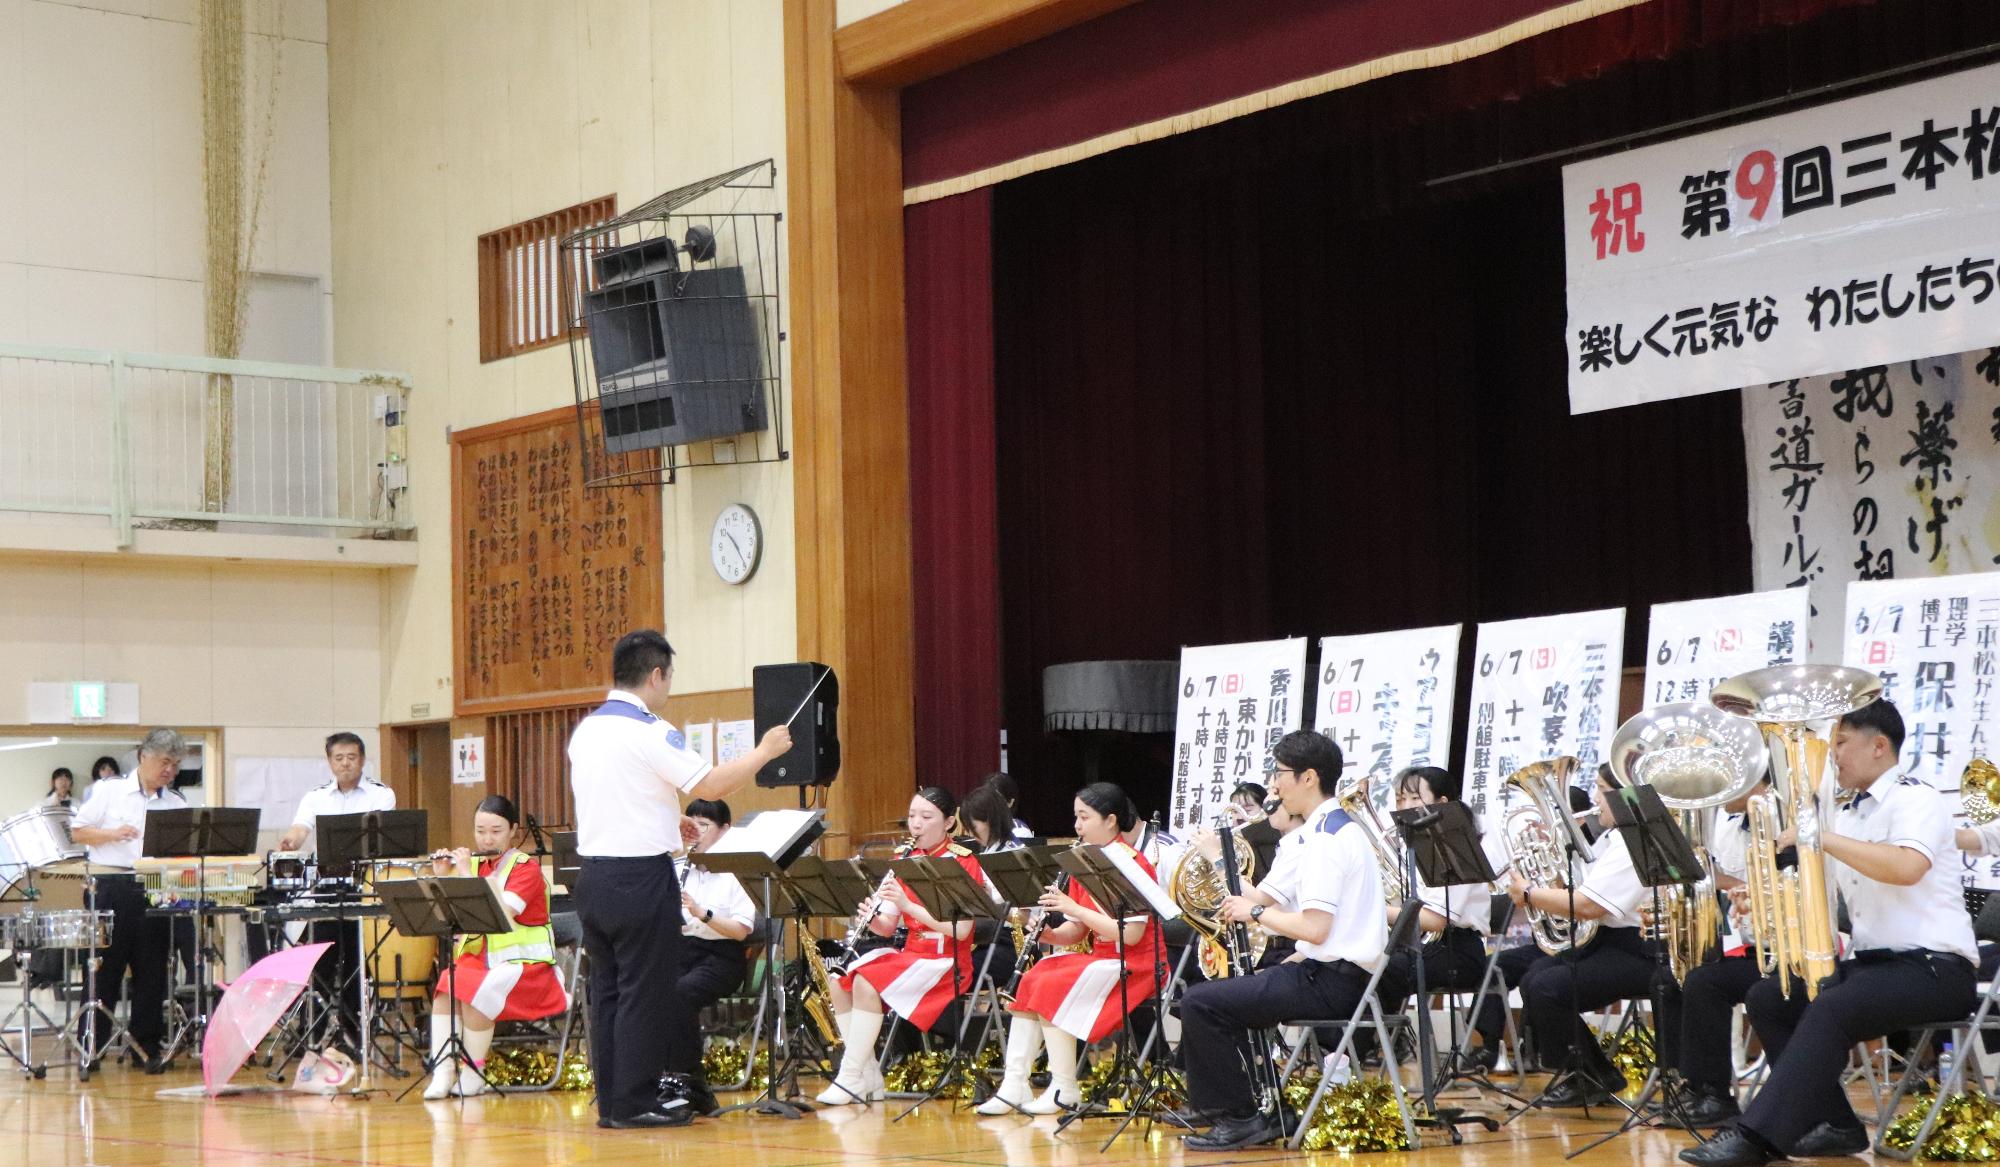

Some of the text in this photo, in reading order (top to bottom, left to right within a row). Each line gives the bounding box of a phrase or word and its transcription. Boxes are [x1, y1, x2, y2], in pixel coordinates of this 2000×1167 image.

[1589, 182, 1645, 260] 祝
[1578, 257, 2000, 373] 楽しく元気な わたしたち
[1855, 604, 1905, 635] 6/7
[1918, 599, 1941, 649] 博士
[1945, 597, 1969, 646] 理学
[1324, 658, 1365, 685] 6/7
[1657, 636, 1701, 666] 6/7
[1329, 689, 1361, 715] (日)
[1210, 708, 1230, 803] 九時四五分
[1174, 742, 1191, 830] 別館駐車場
